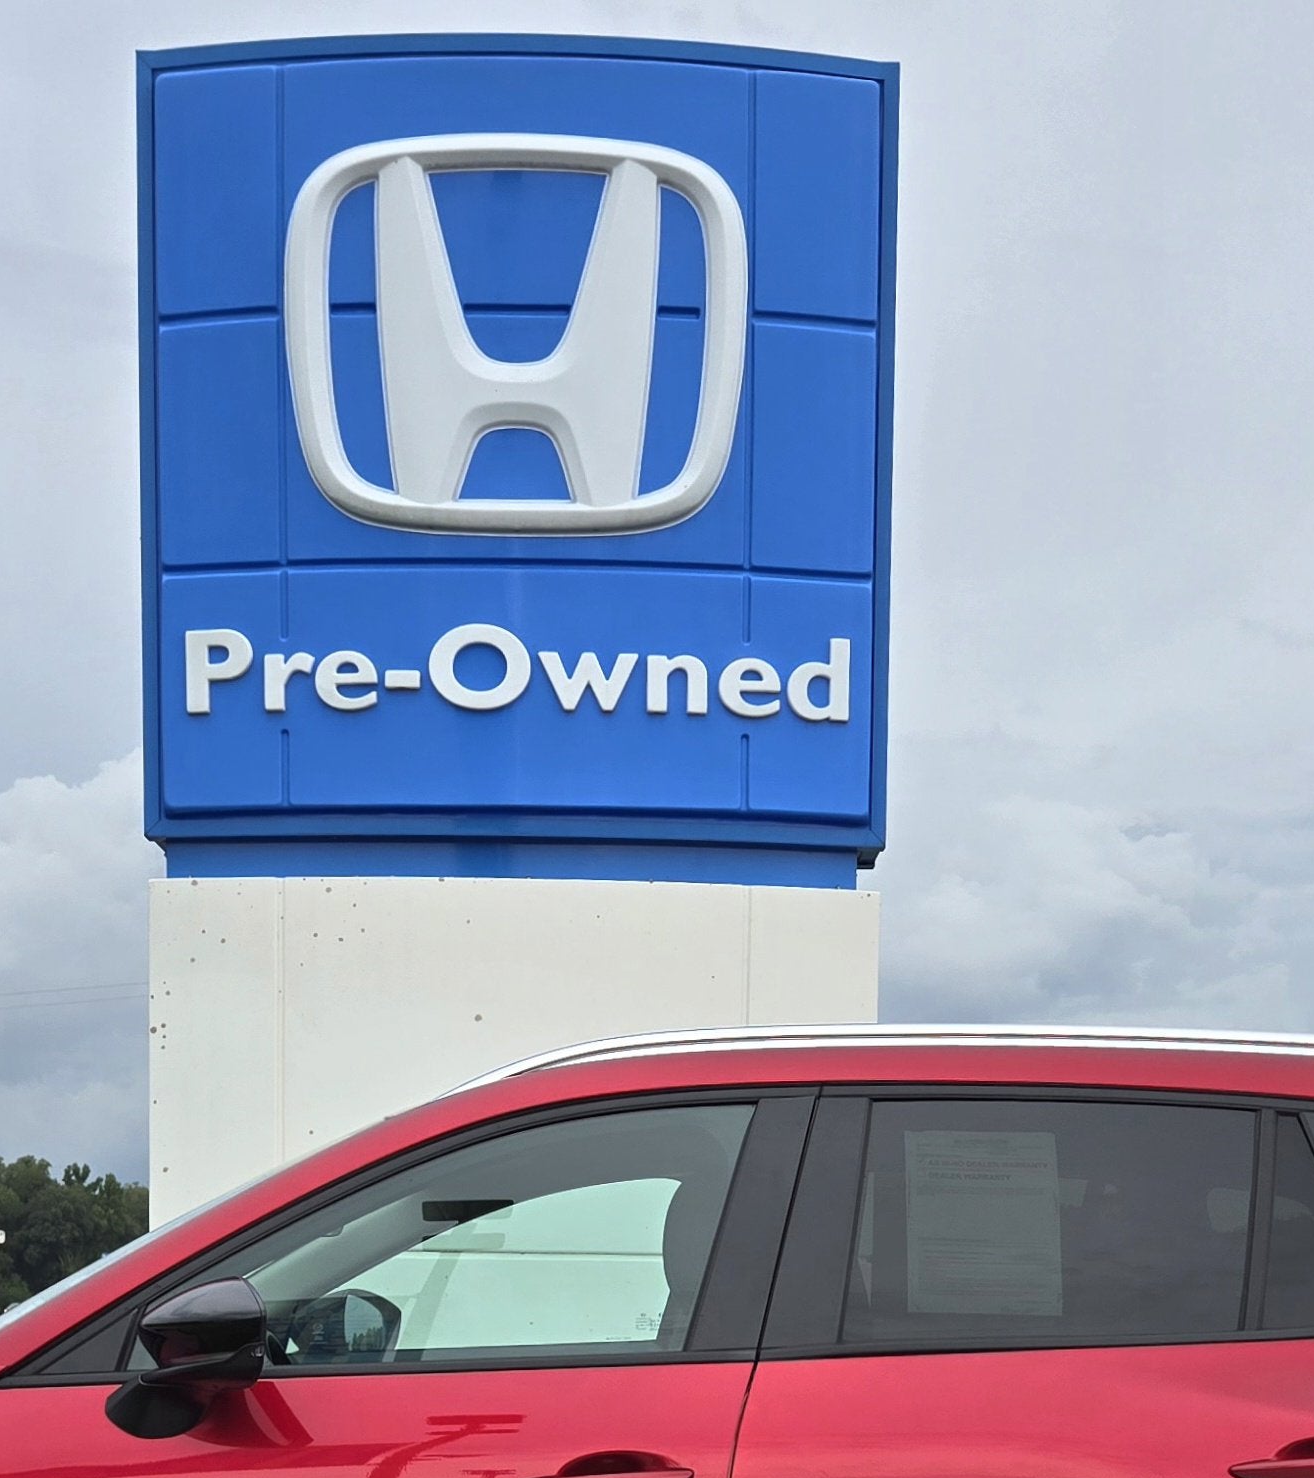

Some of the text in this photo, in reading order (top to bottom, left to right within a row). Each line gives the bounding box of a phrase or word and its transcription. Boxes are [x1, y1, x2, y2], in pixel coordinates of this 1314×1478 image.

[183, 622, 852, 723] Pre-Owned
[1001, 1161, 1048, 1170] WARRANTY
[964, 1173, 1011, 1182] WARRANTY
